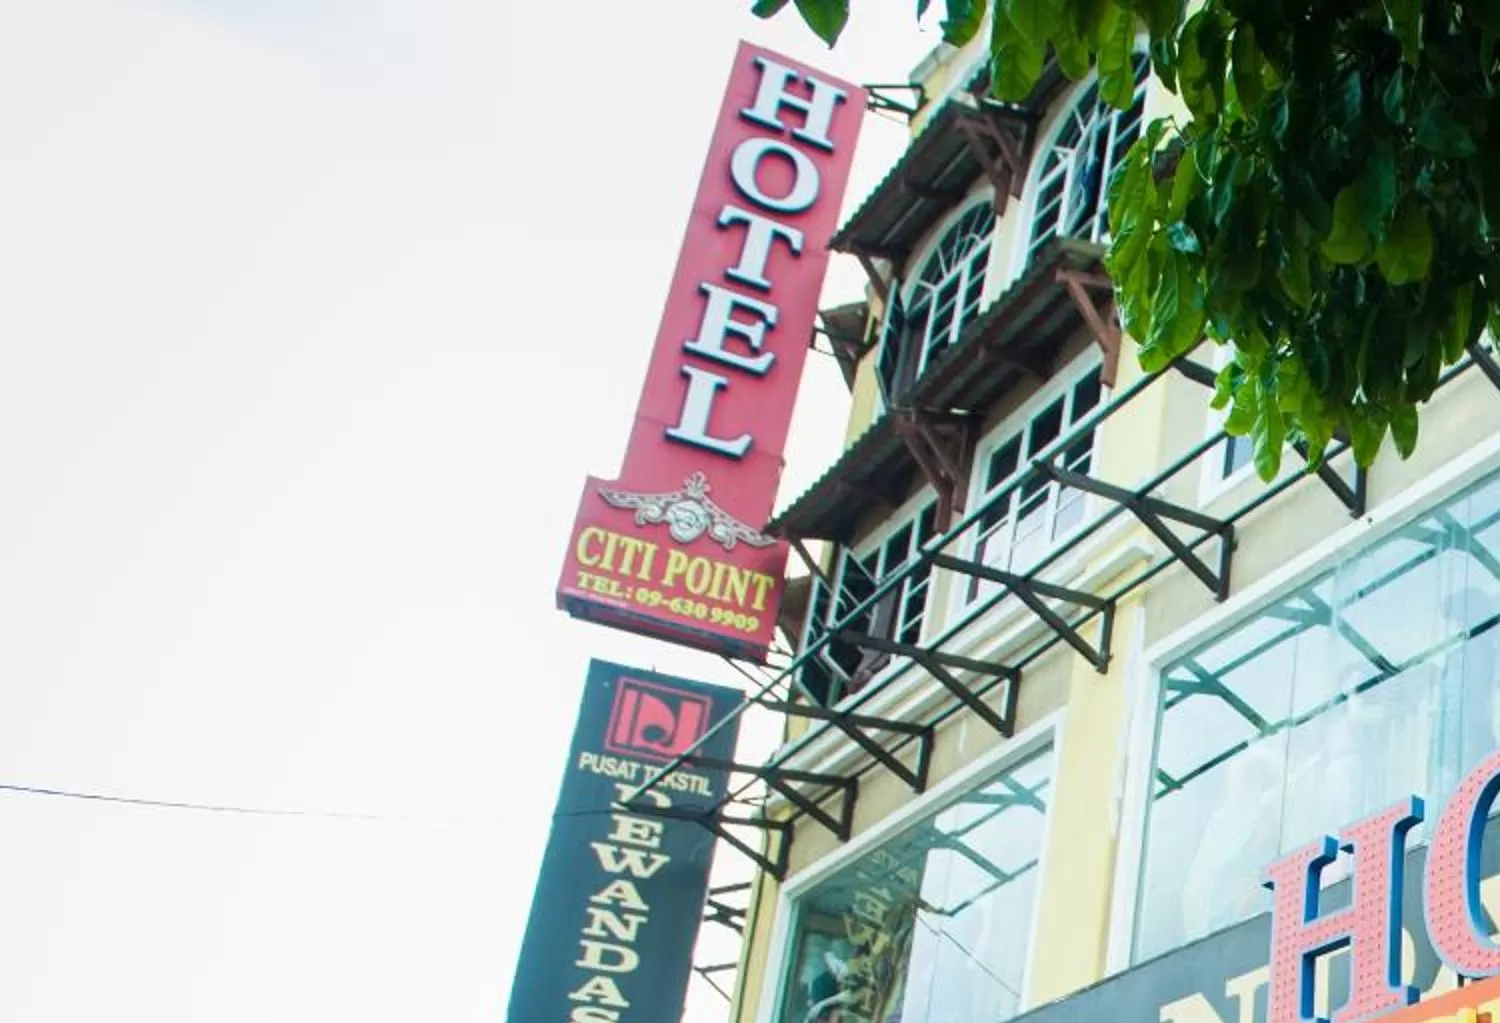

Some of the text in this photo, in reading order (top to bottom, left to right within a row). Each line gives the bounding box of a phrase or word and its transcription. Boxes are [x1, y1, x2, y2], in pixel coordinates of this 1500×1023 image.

[664, 55, 848, 460] HOTEL
[576, 526, 775, 611] CITI POINT
[635, 586, 708, 620] 09-630
[710, 607, 760, 632] 9909
[578, 751, 640, 780] PUSAT
